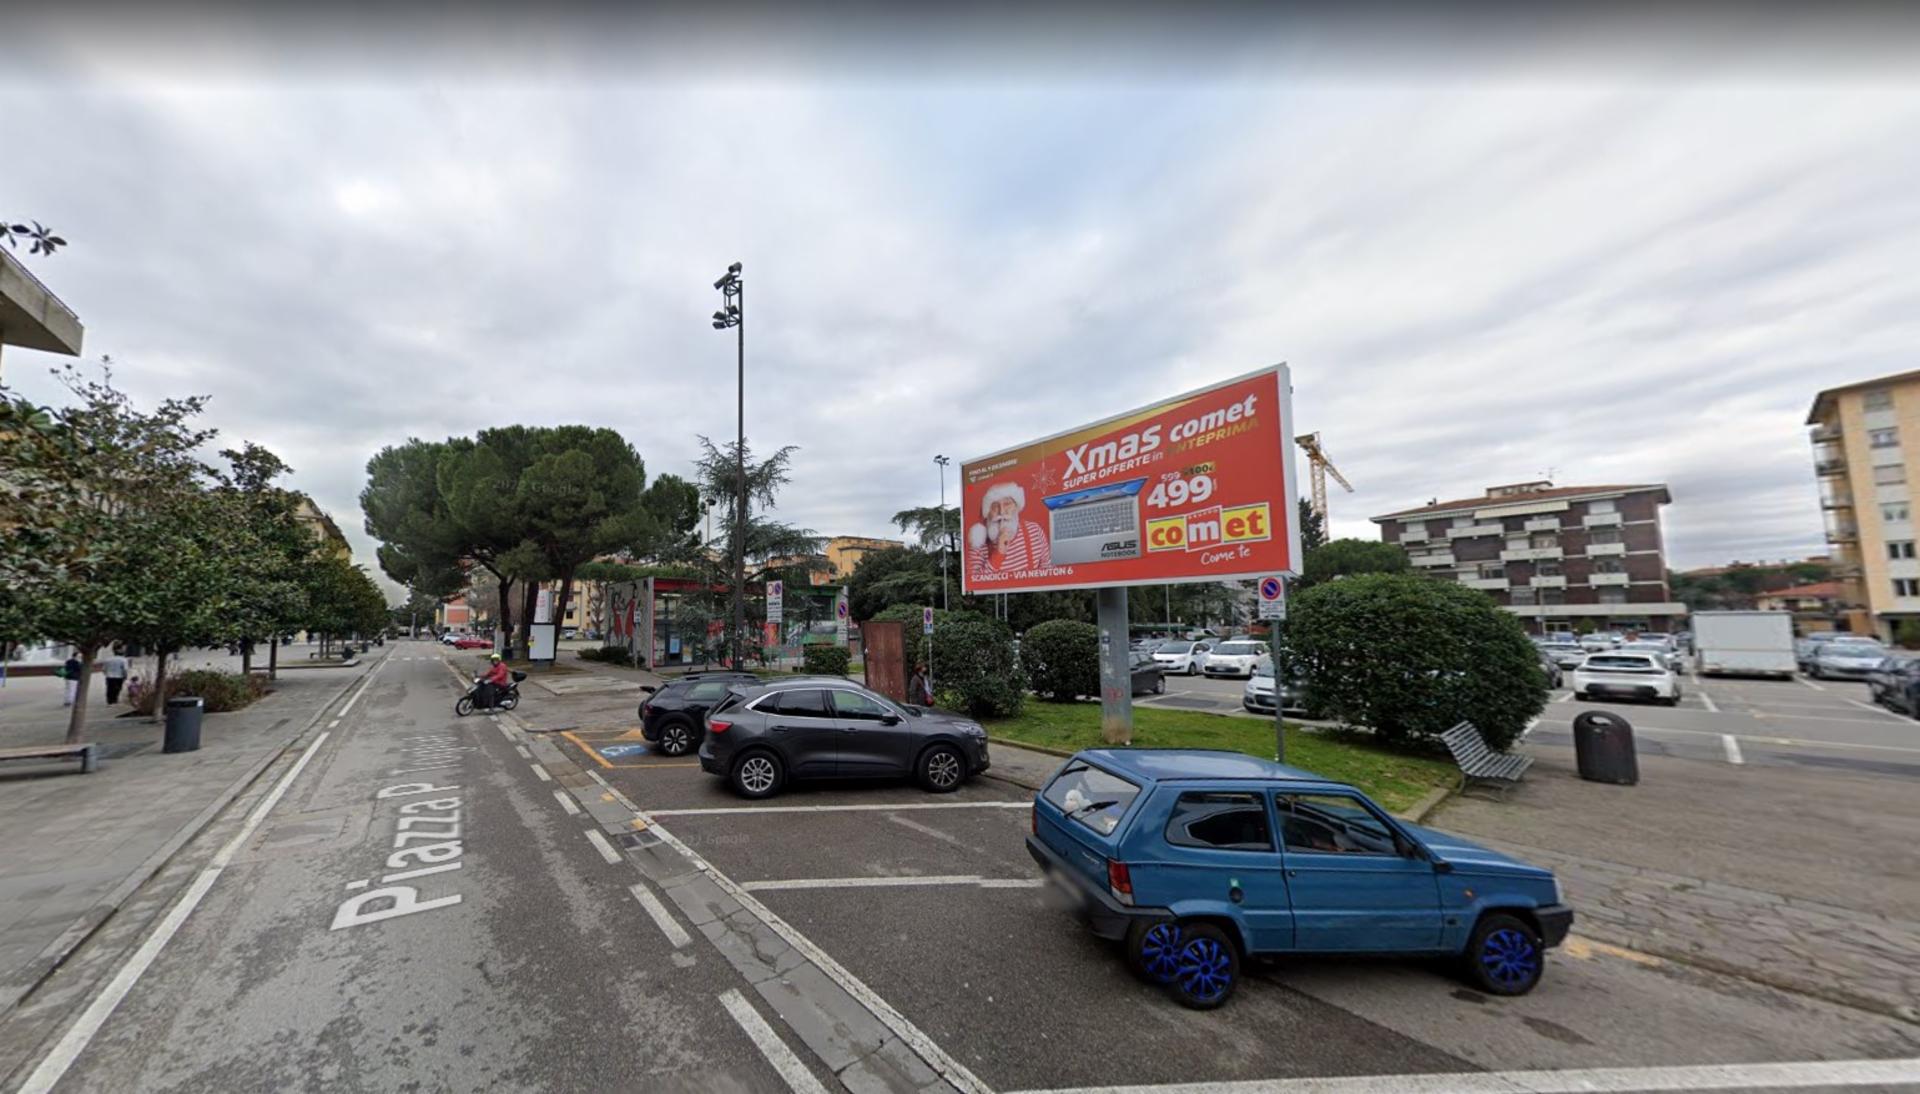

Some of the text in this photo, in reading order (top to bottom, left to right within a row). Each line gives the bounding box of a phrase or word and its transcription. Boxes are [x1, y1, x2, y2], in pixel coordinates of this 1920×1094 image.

[1062, 393, 1257, 480] Xmas comet
[1063, 417, 1259, 490] SUPER OFFERTE in NTEPRIMA
[1161, 471, 1181, 482] 599
[1147, 475, 1213, 509] 499
[1150, 509, 1265, 548] comet
[1101, 540, 1137, 551] ASUS
[1200, 544, 1251, 566] Come te
[970, 567, 1074, 582] SCANDICCI VIA NEWTON 6
